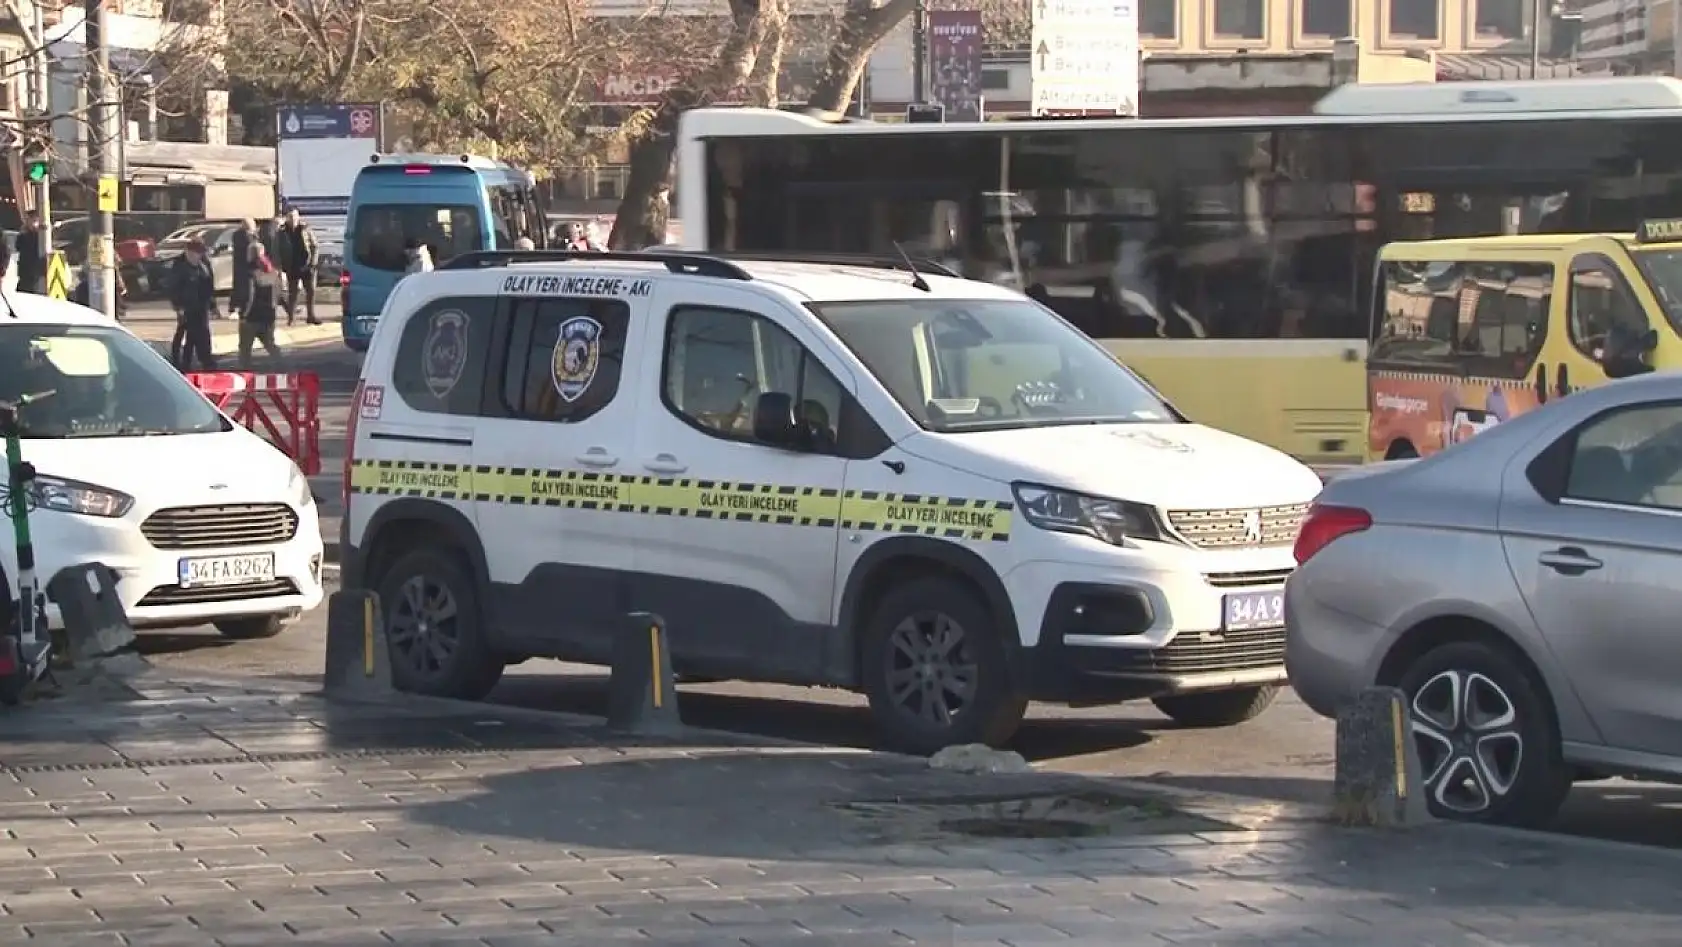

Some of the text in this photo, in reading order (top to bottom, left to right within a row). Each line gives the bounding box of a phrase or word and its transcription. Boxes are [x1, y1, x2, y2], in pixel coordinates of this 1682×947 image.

[503, 275, 534, 292] OLAY
[532, 480, 552, 494] OLAY
[701, 492, 725, 507] OLAY
[887, 504, 914, 520] OLAY
[1231, 597, 1252, 622] 34
[1253, 595, 1270, 620] A
